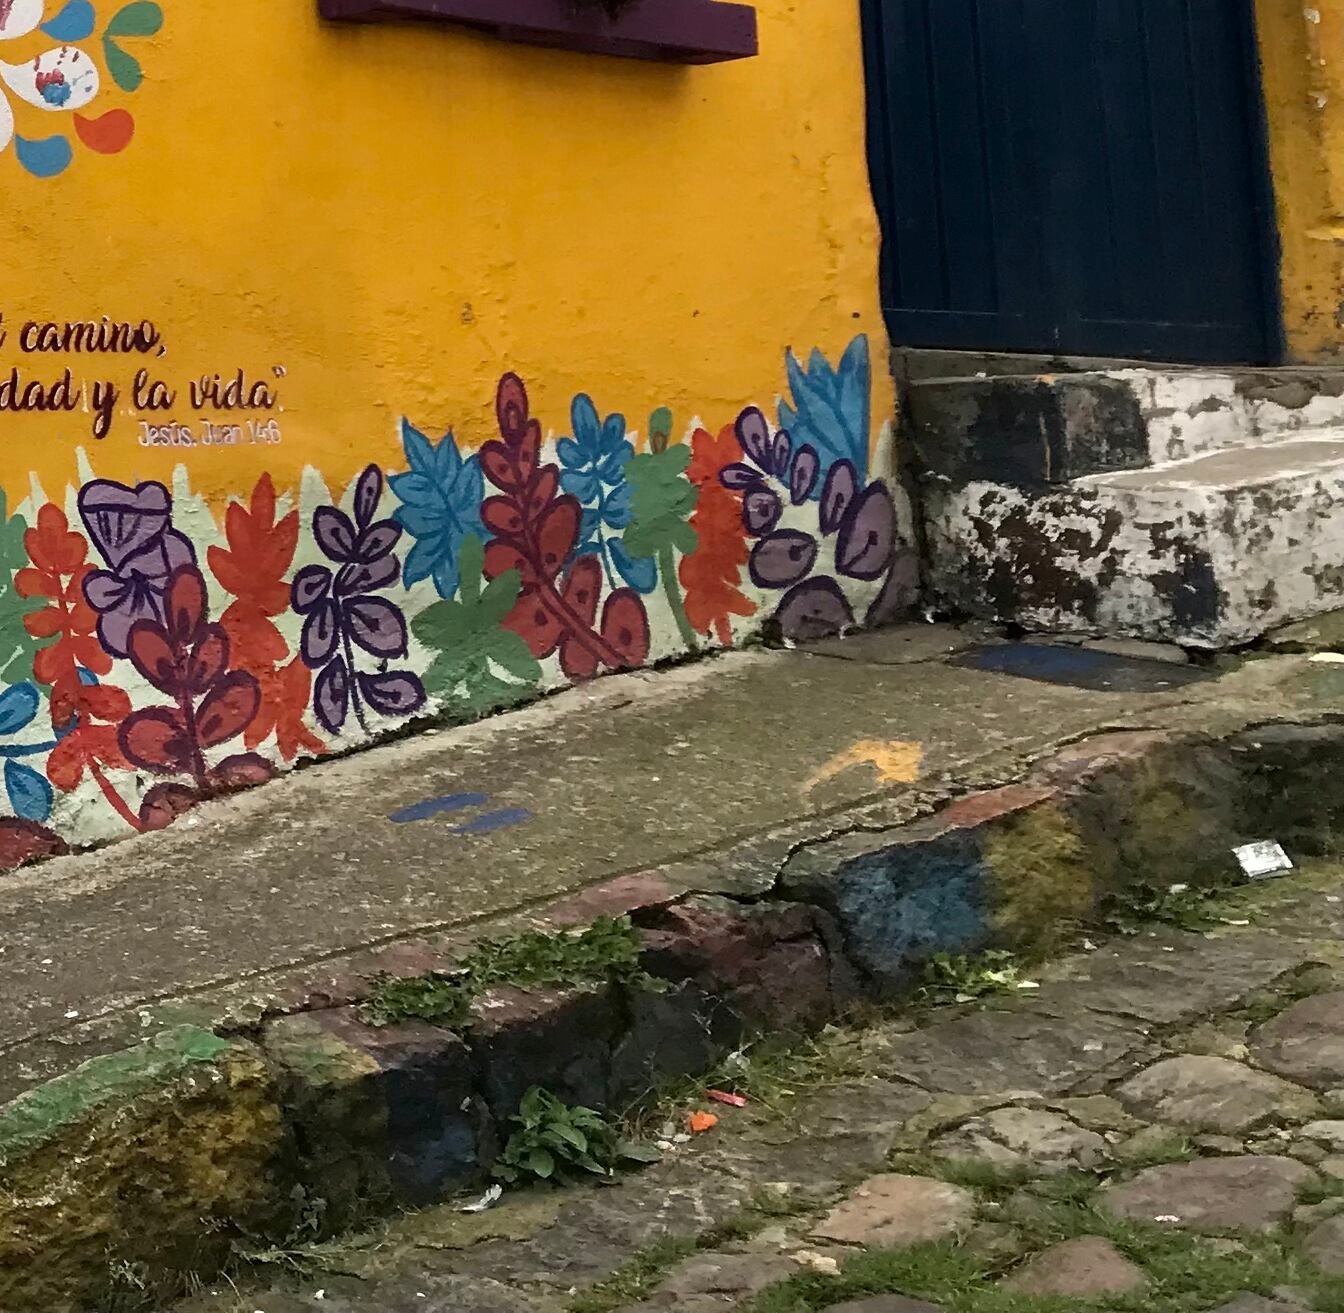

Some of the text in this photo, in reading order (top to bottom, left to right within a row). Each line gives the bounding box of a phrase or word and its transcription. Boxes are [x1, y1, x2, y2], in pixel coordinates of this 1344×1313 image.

[19, 315, 167, 358] camino,
[90, 376, 120, 440] y
[132, 368, 177, 411] la
[199, 418, 244, 445] Juan
